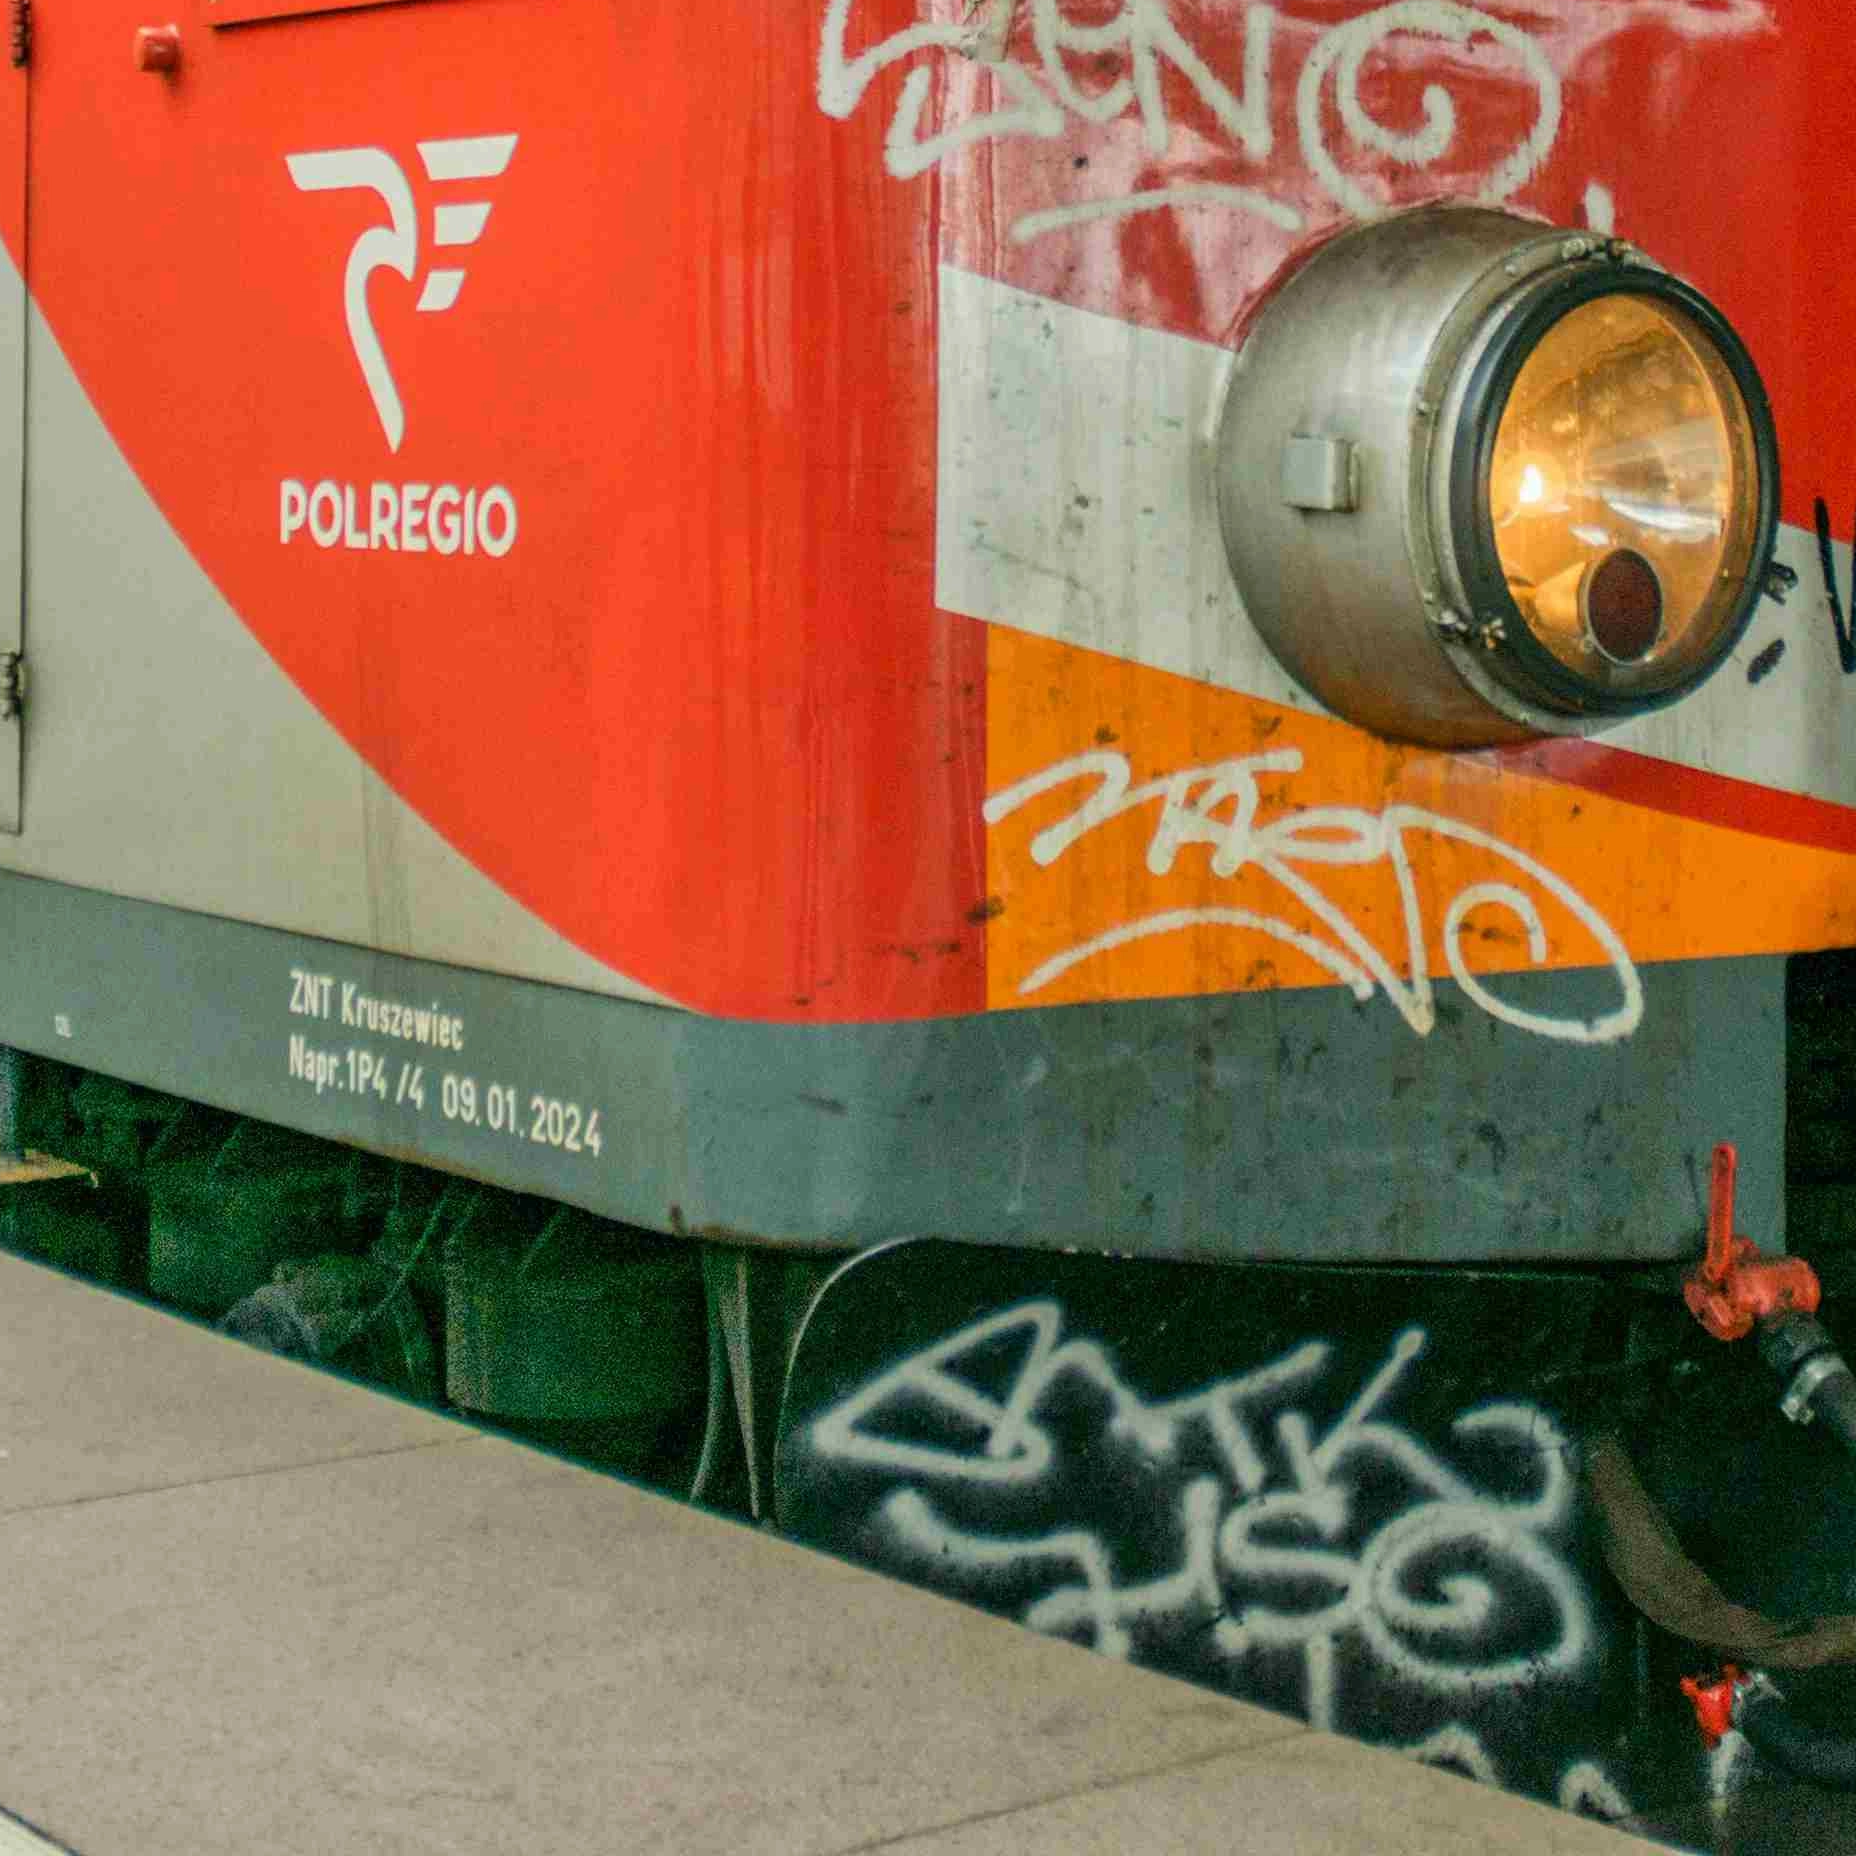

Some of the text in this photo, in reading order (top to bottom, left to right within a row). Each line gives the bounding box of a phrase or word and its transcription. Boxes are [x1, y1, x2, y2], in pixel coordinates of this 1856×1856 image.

[279, 479, 518, 558] POLREGIO
[289, 968, 465, 1052] ZNT Kruszewiec
